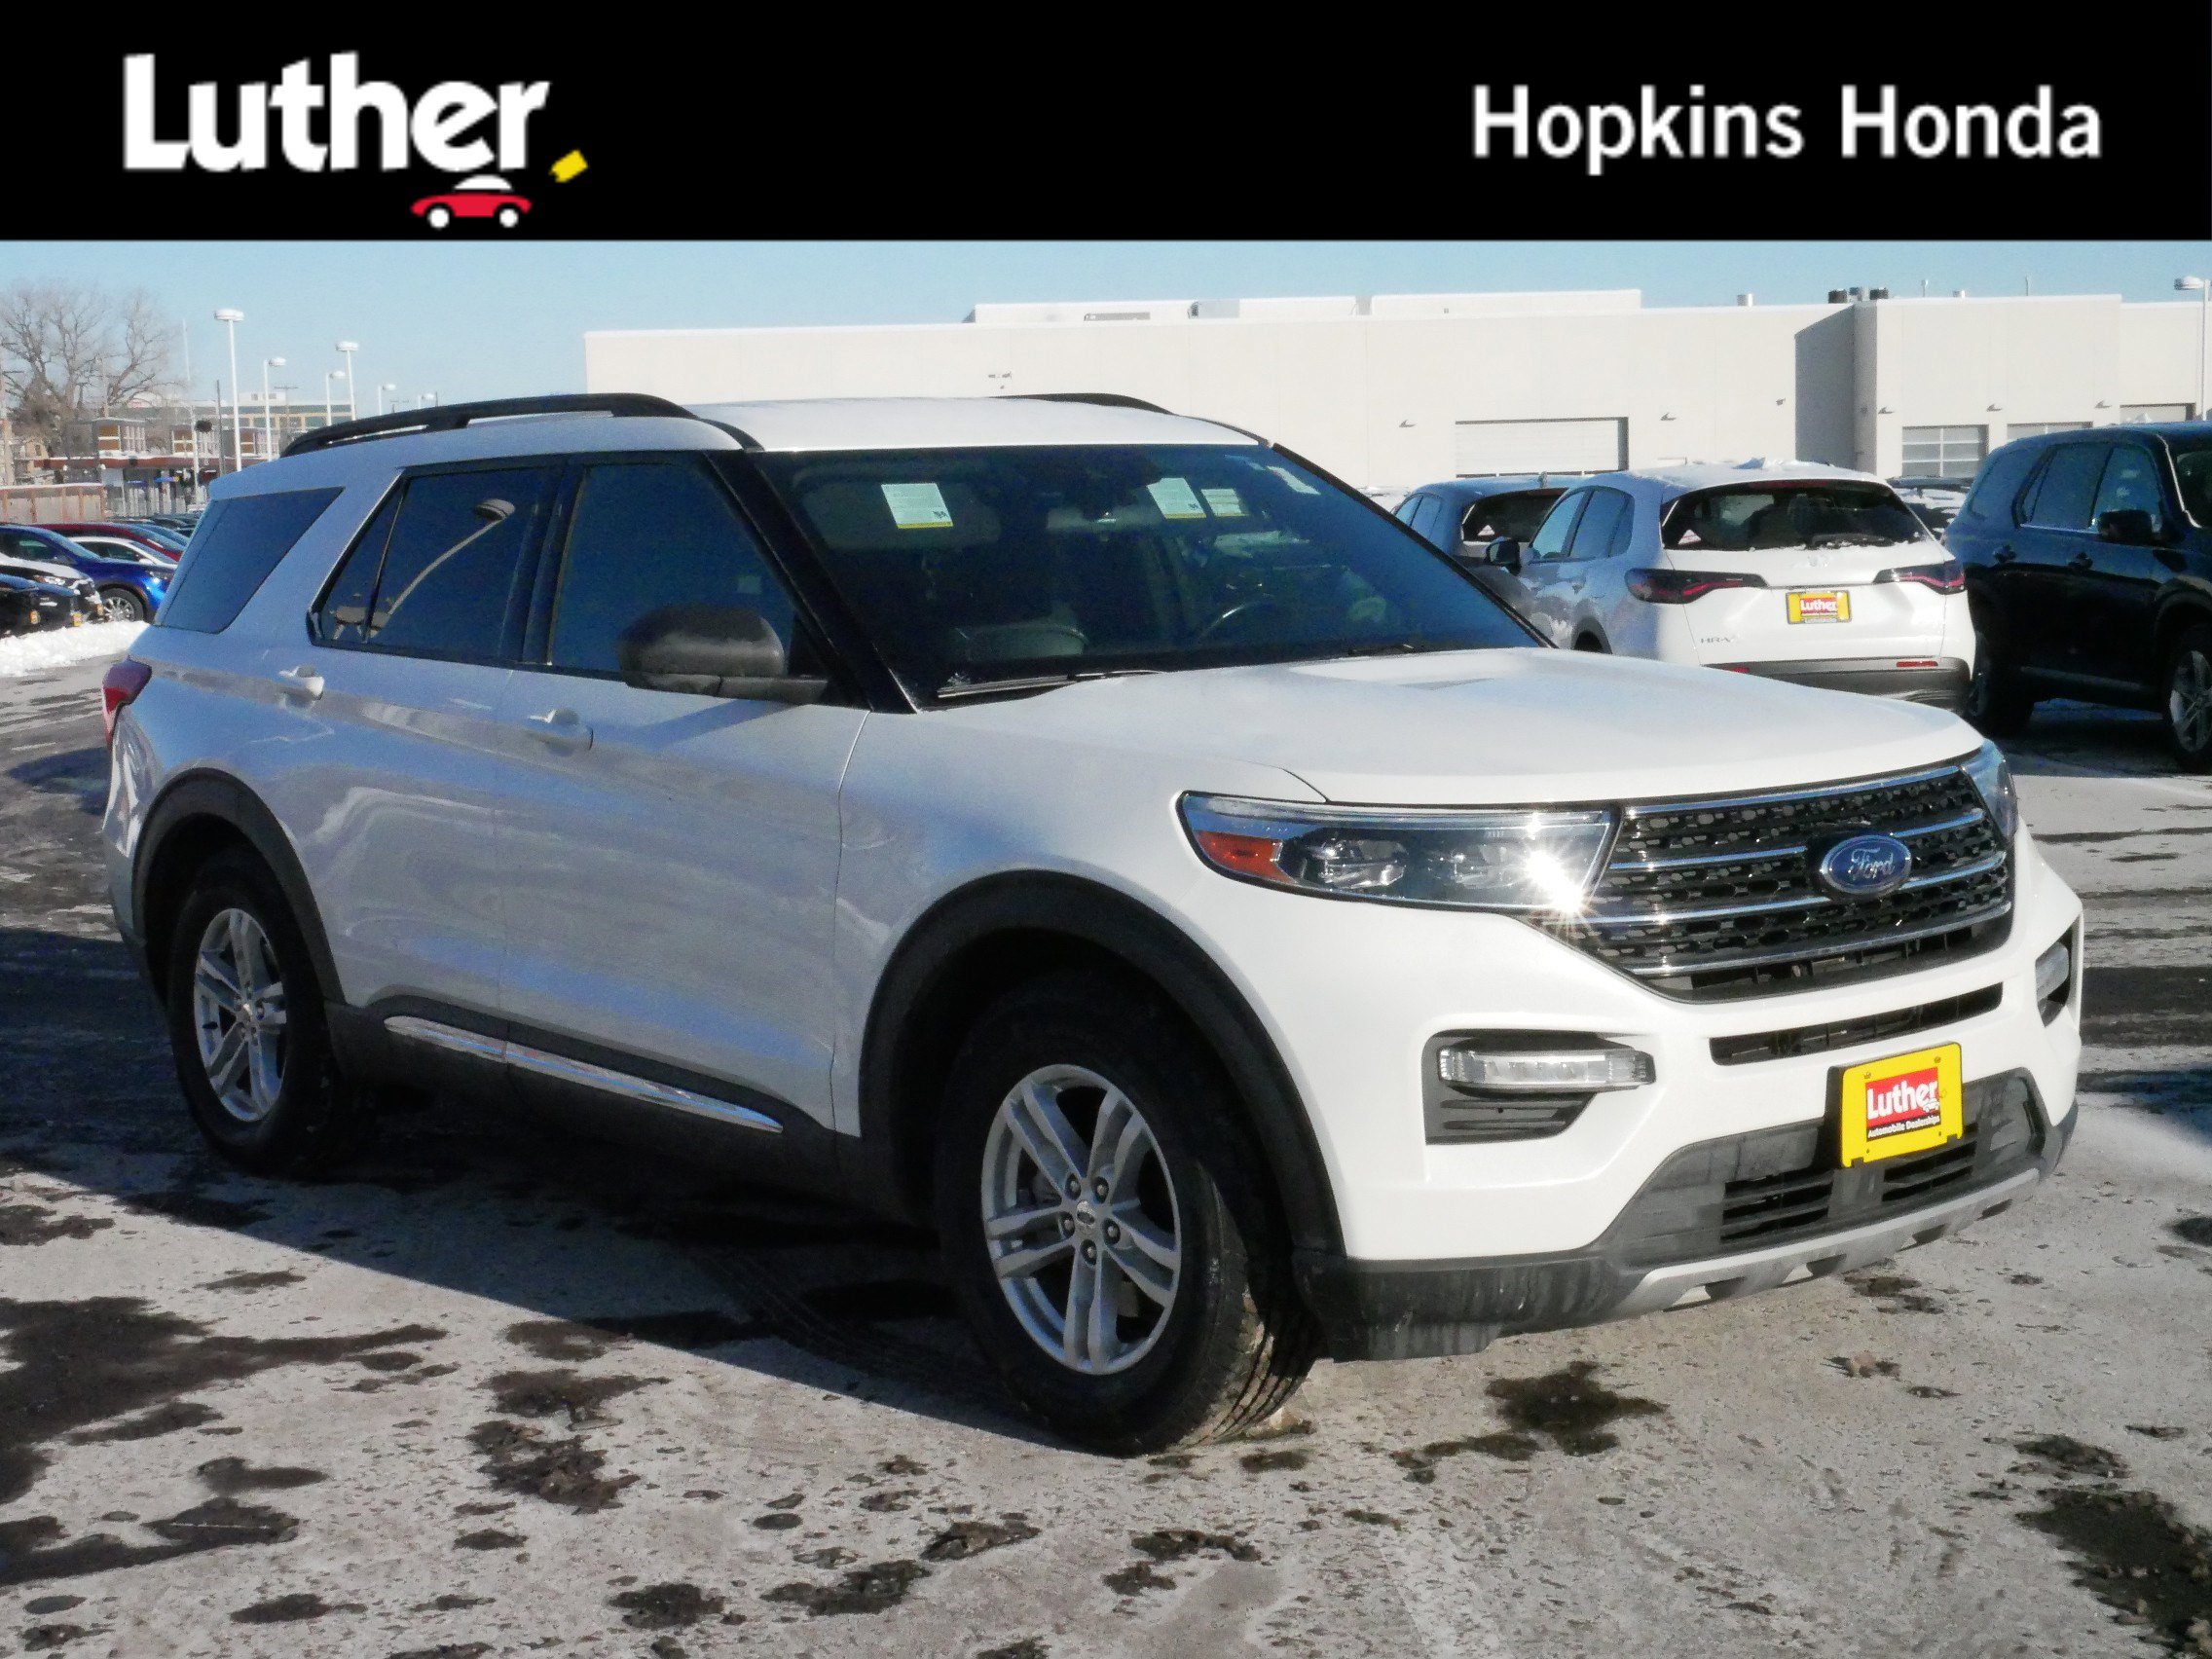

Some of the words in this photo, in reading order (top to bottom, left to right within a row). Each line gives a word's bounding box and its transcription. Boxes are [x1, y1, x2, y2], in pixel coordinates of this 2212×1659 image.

[1800, 599, 1837, 612] Luther
[1849, 847, 1896, 878] Ford
[1866, 1080, 1938, 1120] Luther
